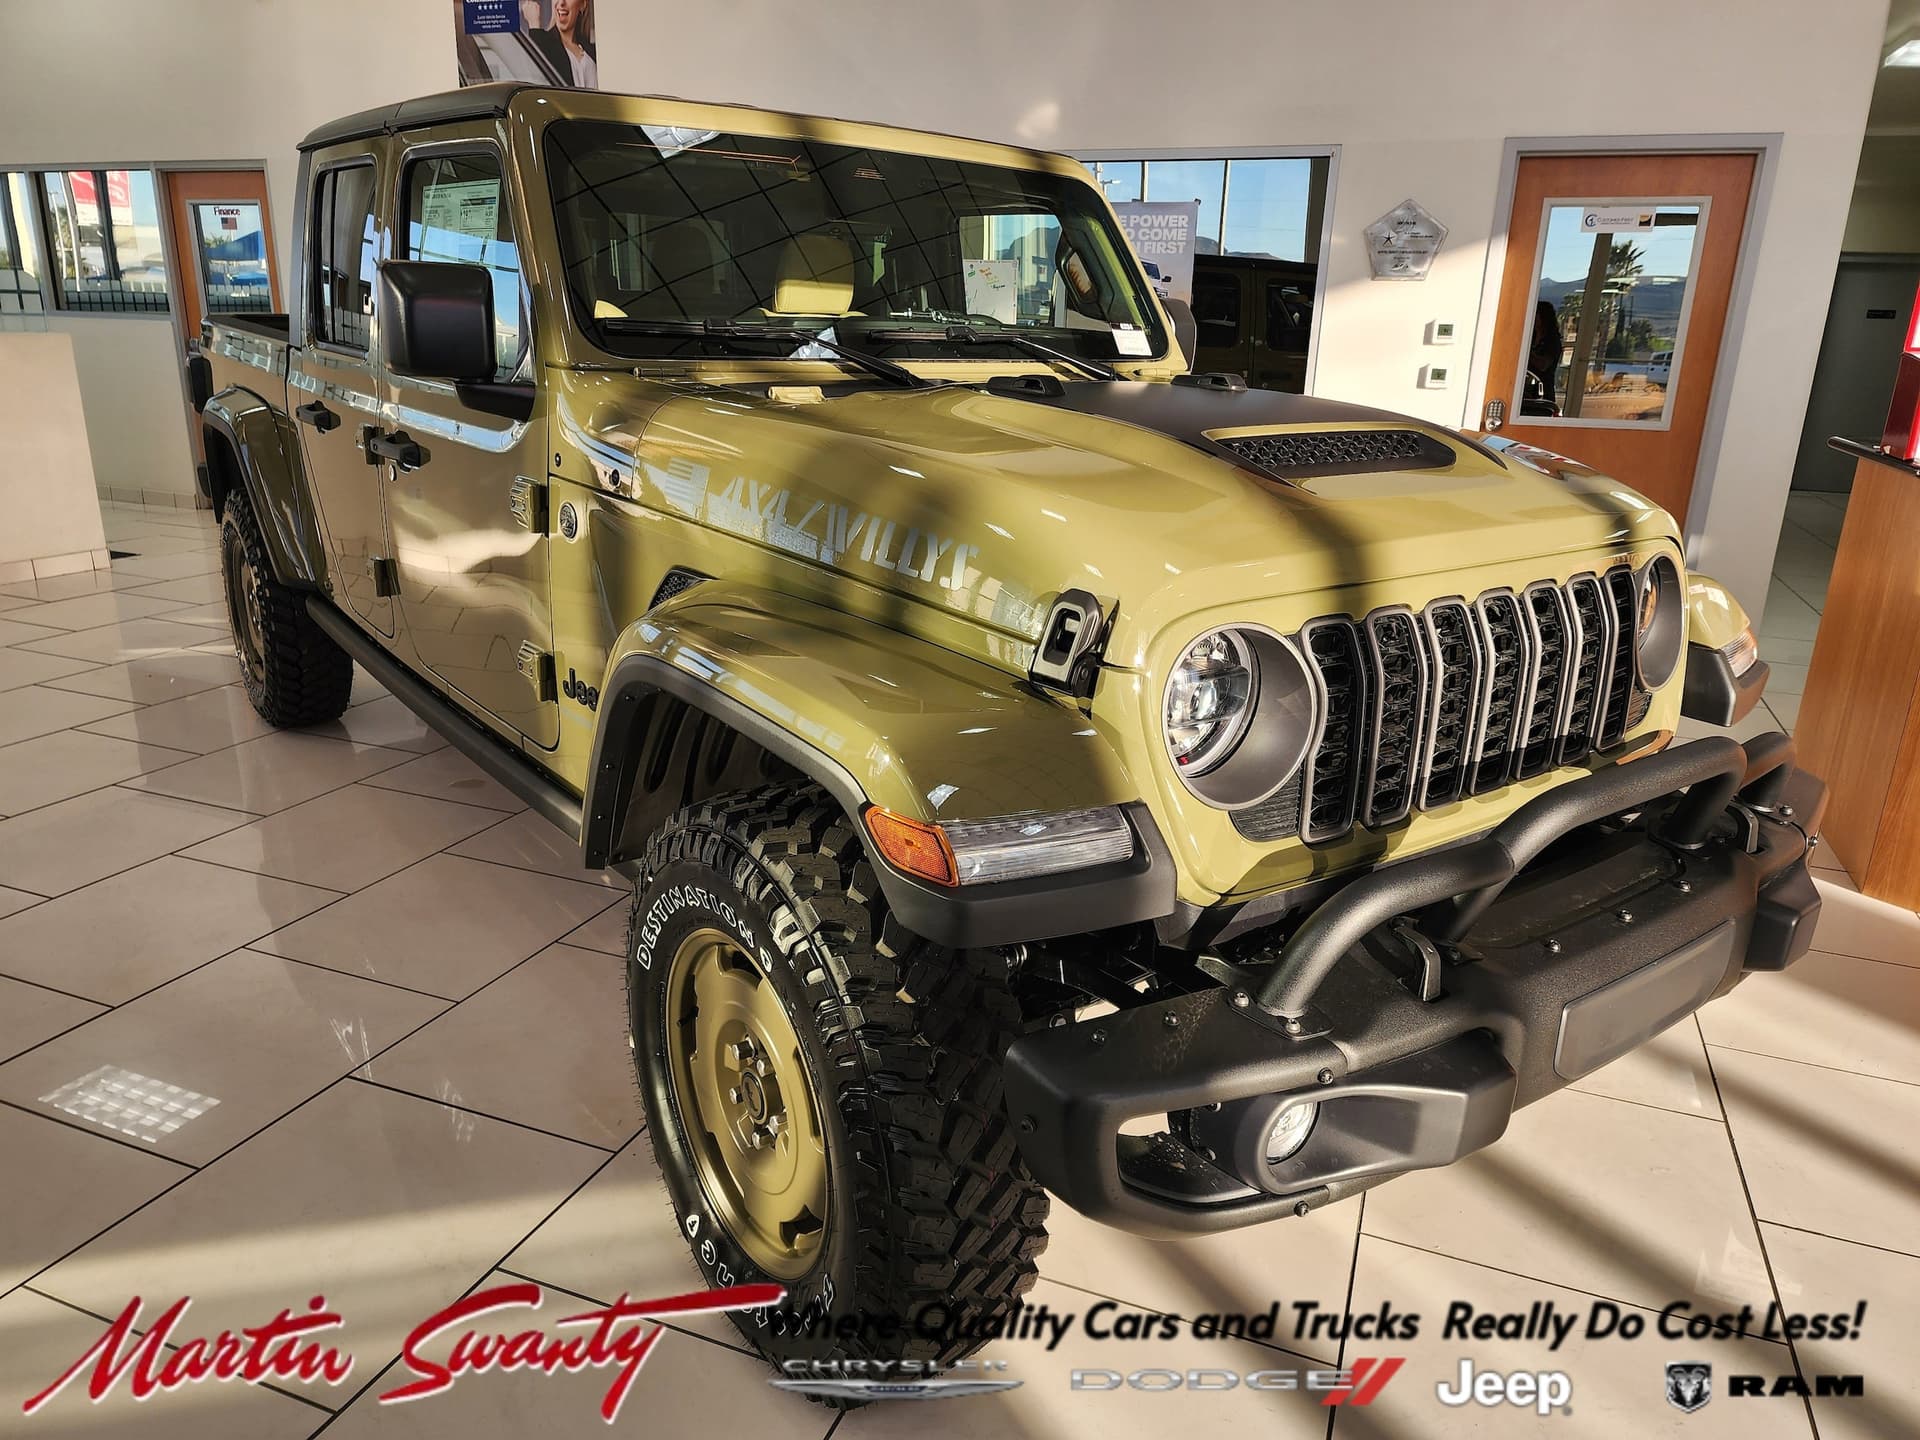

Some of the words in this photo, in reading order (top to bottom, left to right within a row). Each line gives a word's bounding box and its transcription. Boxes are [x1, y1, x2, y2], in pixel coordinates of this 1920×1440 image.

[1130, 215, 1189, 227] POWER
[1138, 228, 1187, 240] COME
[1144, 241, 1186, 254] FIRST
[562, 667, 599, 713] Jee
[636, 883, 755, 971] DESTINATION
